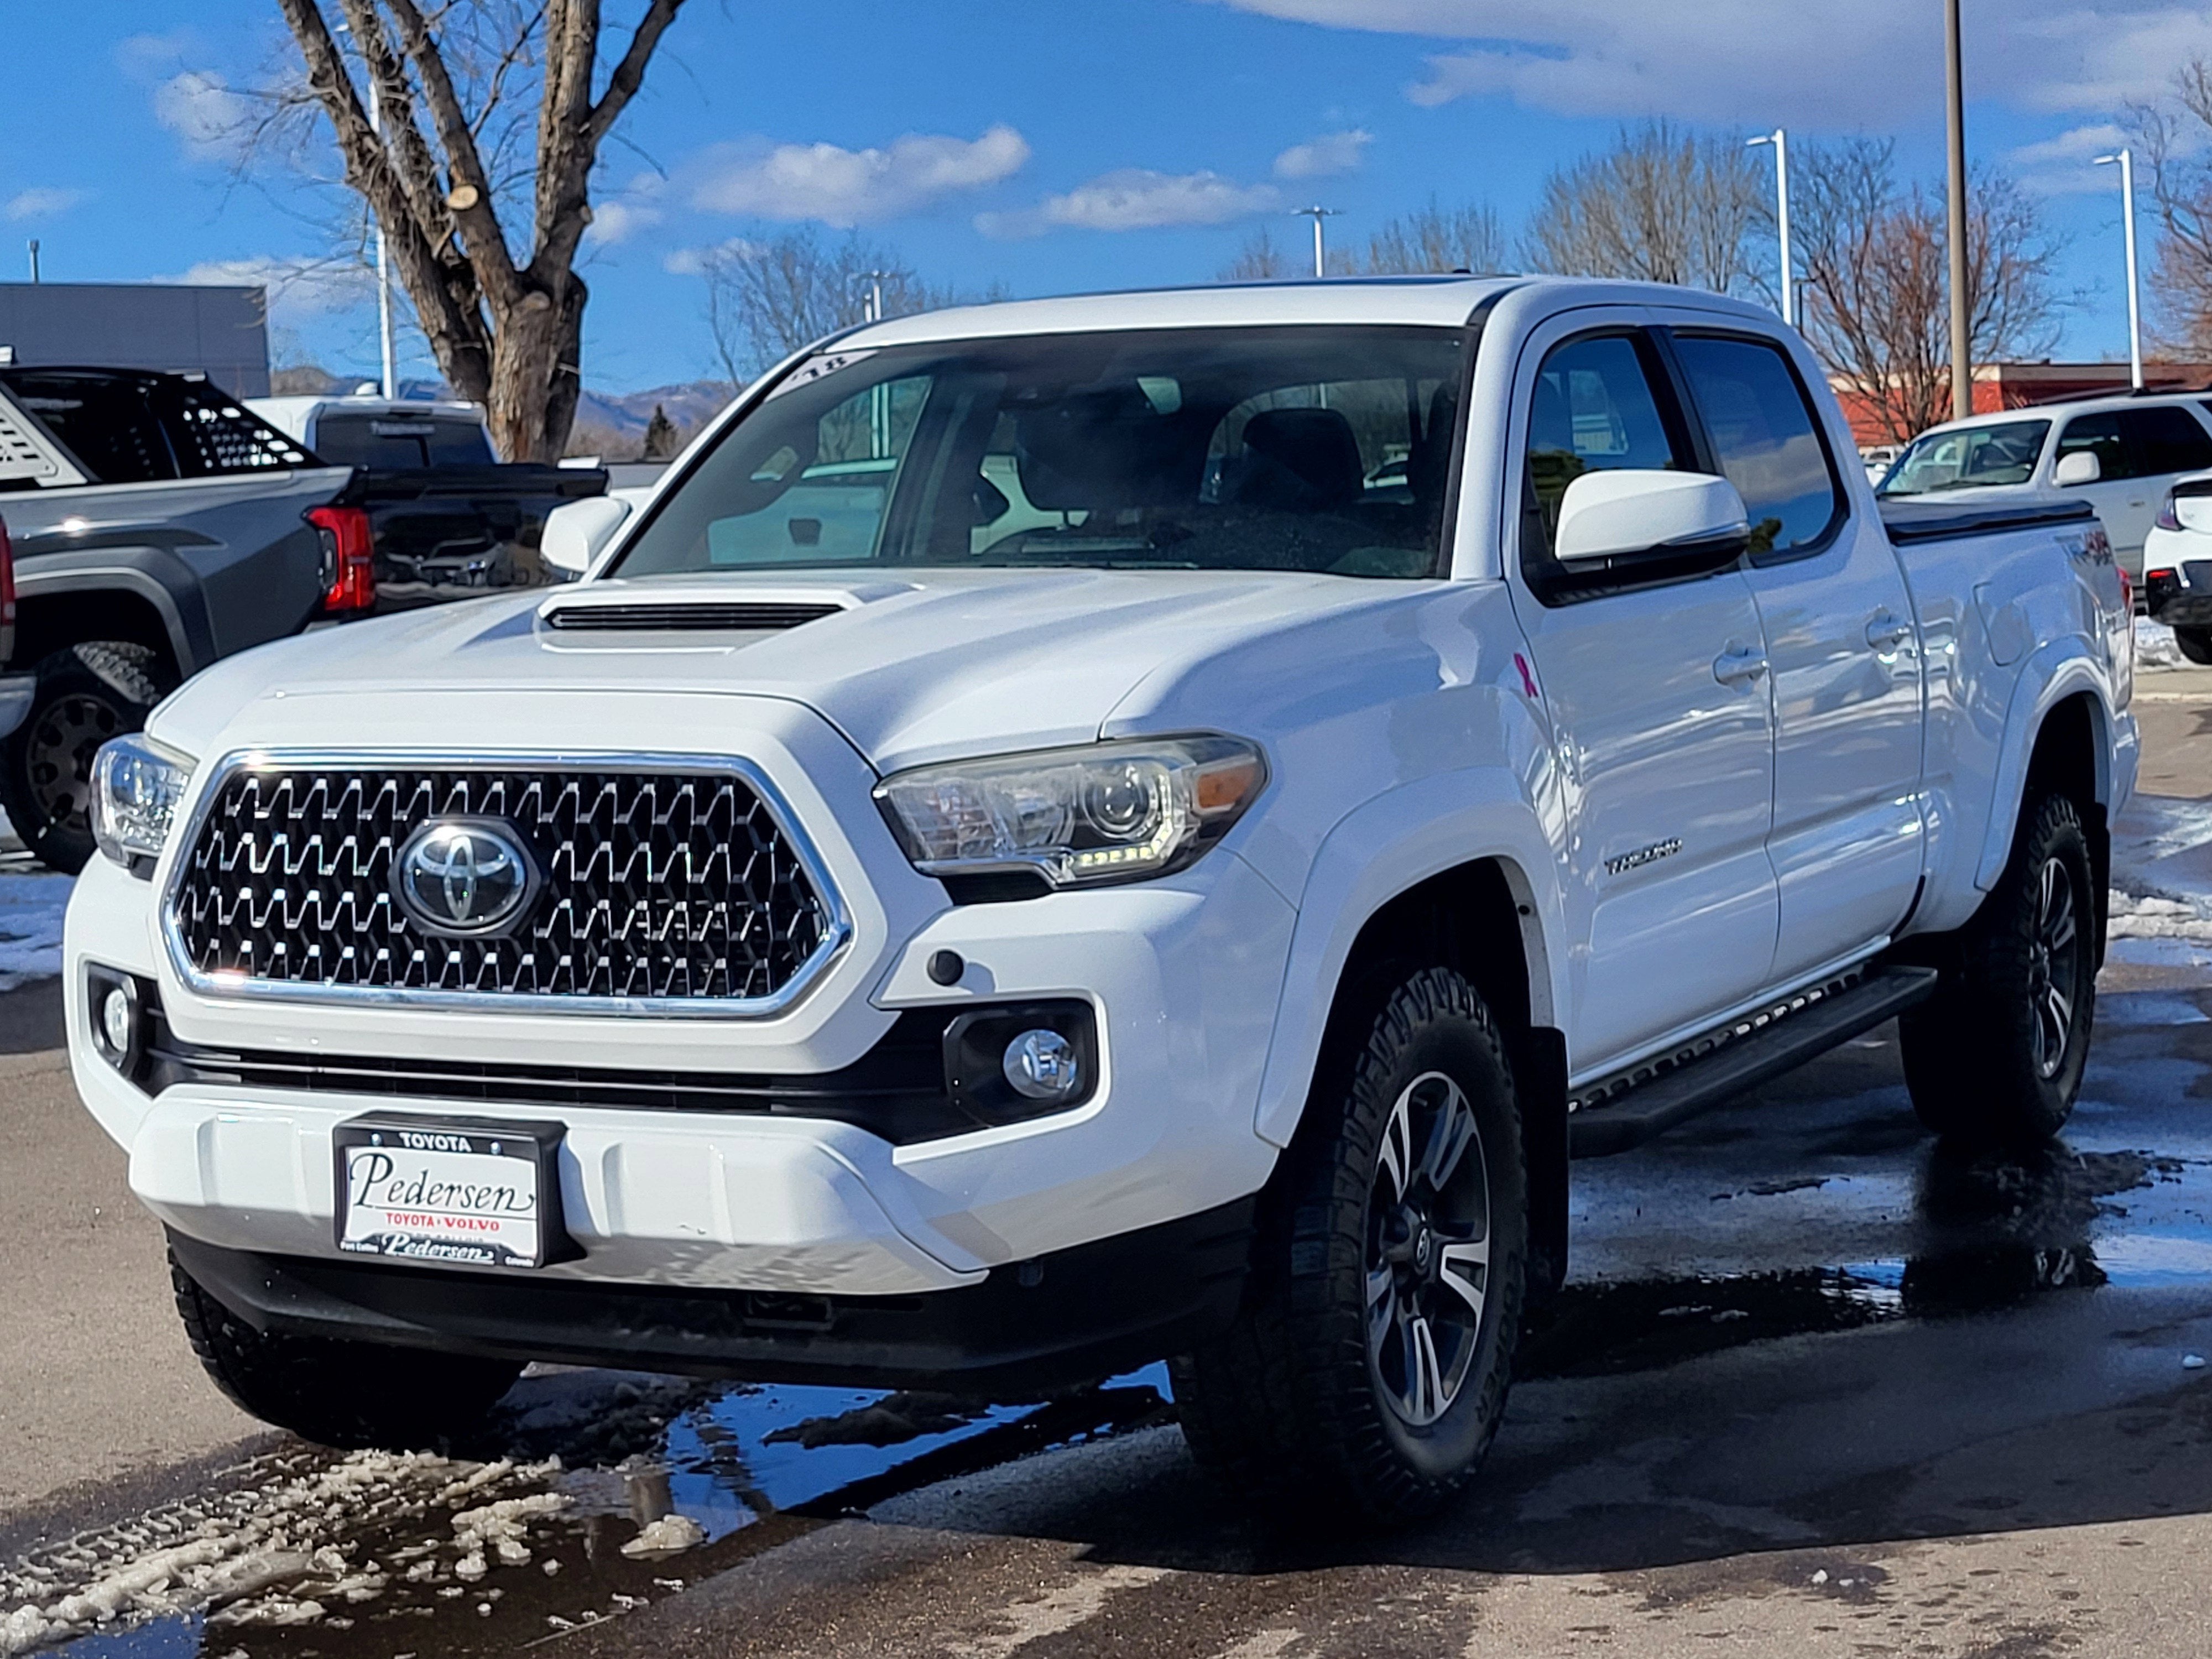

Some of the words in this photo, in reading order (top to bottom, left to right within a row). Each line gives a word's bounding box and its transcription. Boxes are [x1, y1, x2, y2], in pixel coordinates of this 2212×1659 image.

[398, 1132, 472, 1152] TOYOTA
[350, 1153, 535, 1212] Pedersen
[386, 1212, 434, 1227] TOYOTA
[444, 1217, 500, 1232] VOLVO
[382, 1232, 494, 1260] Pedersen
